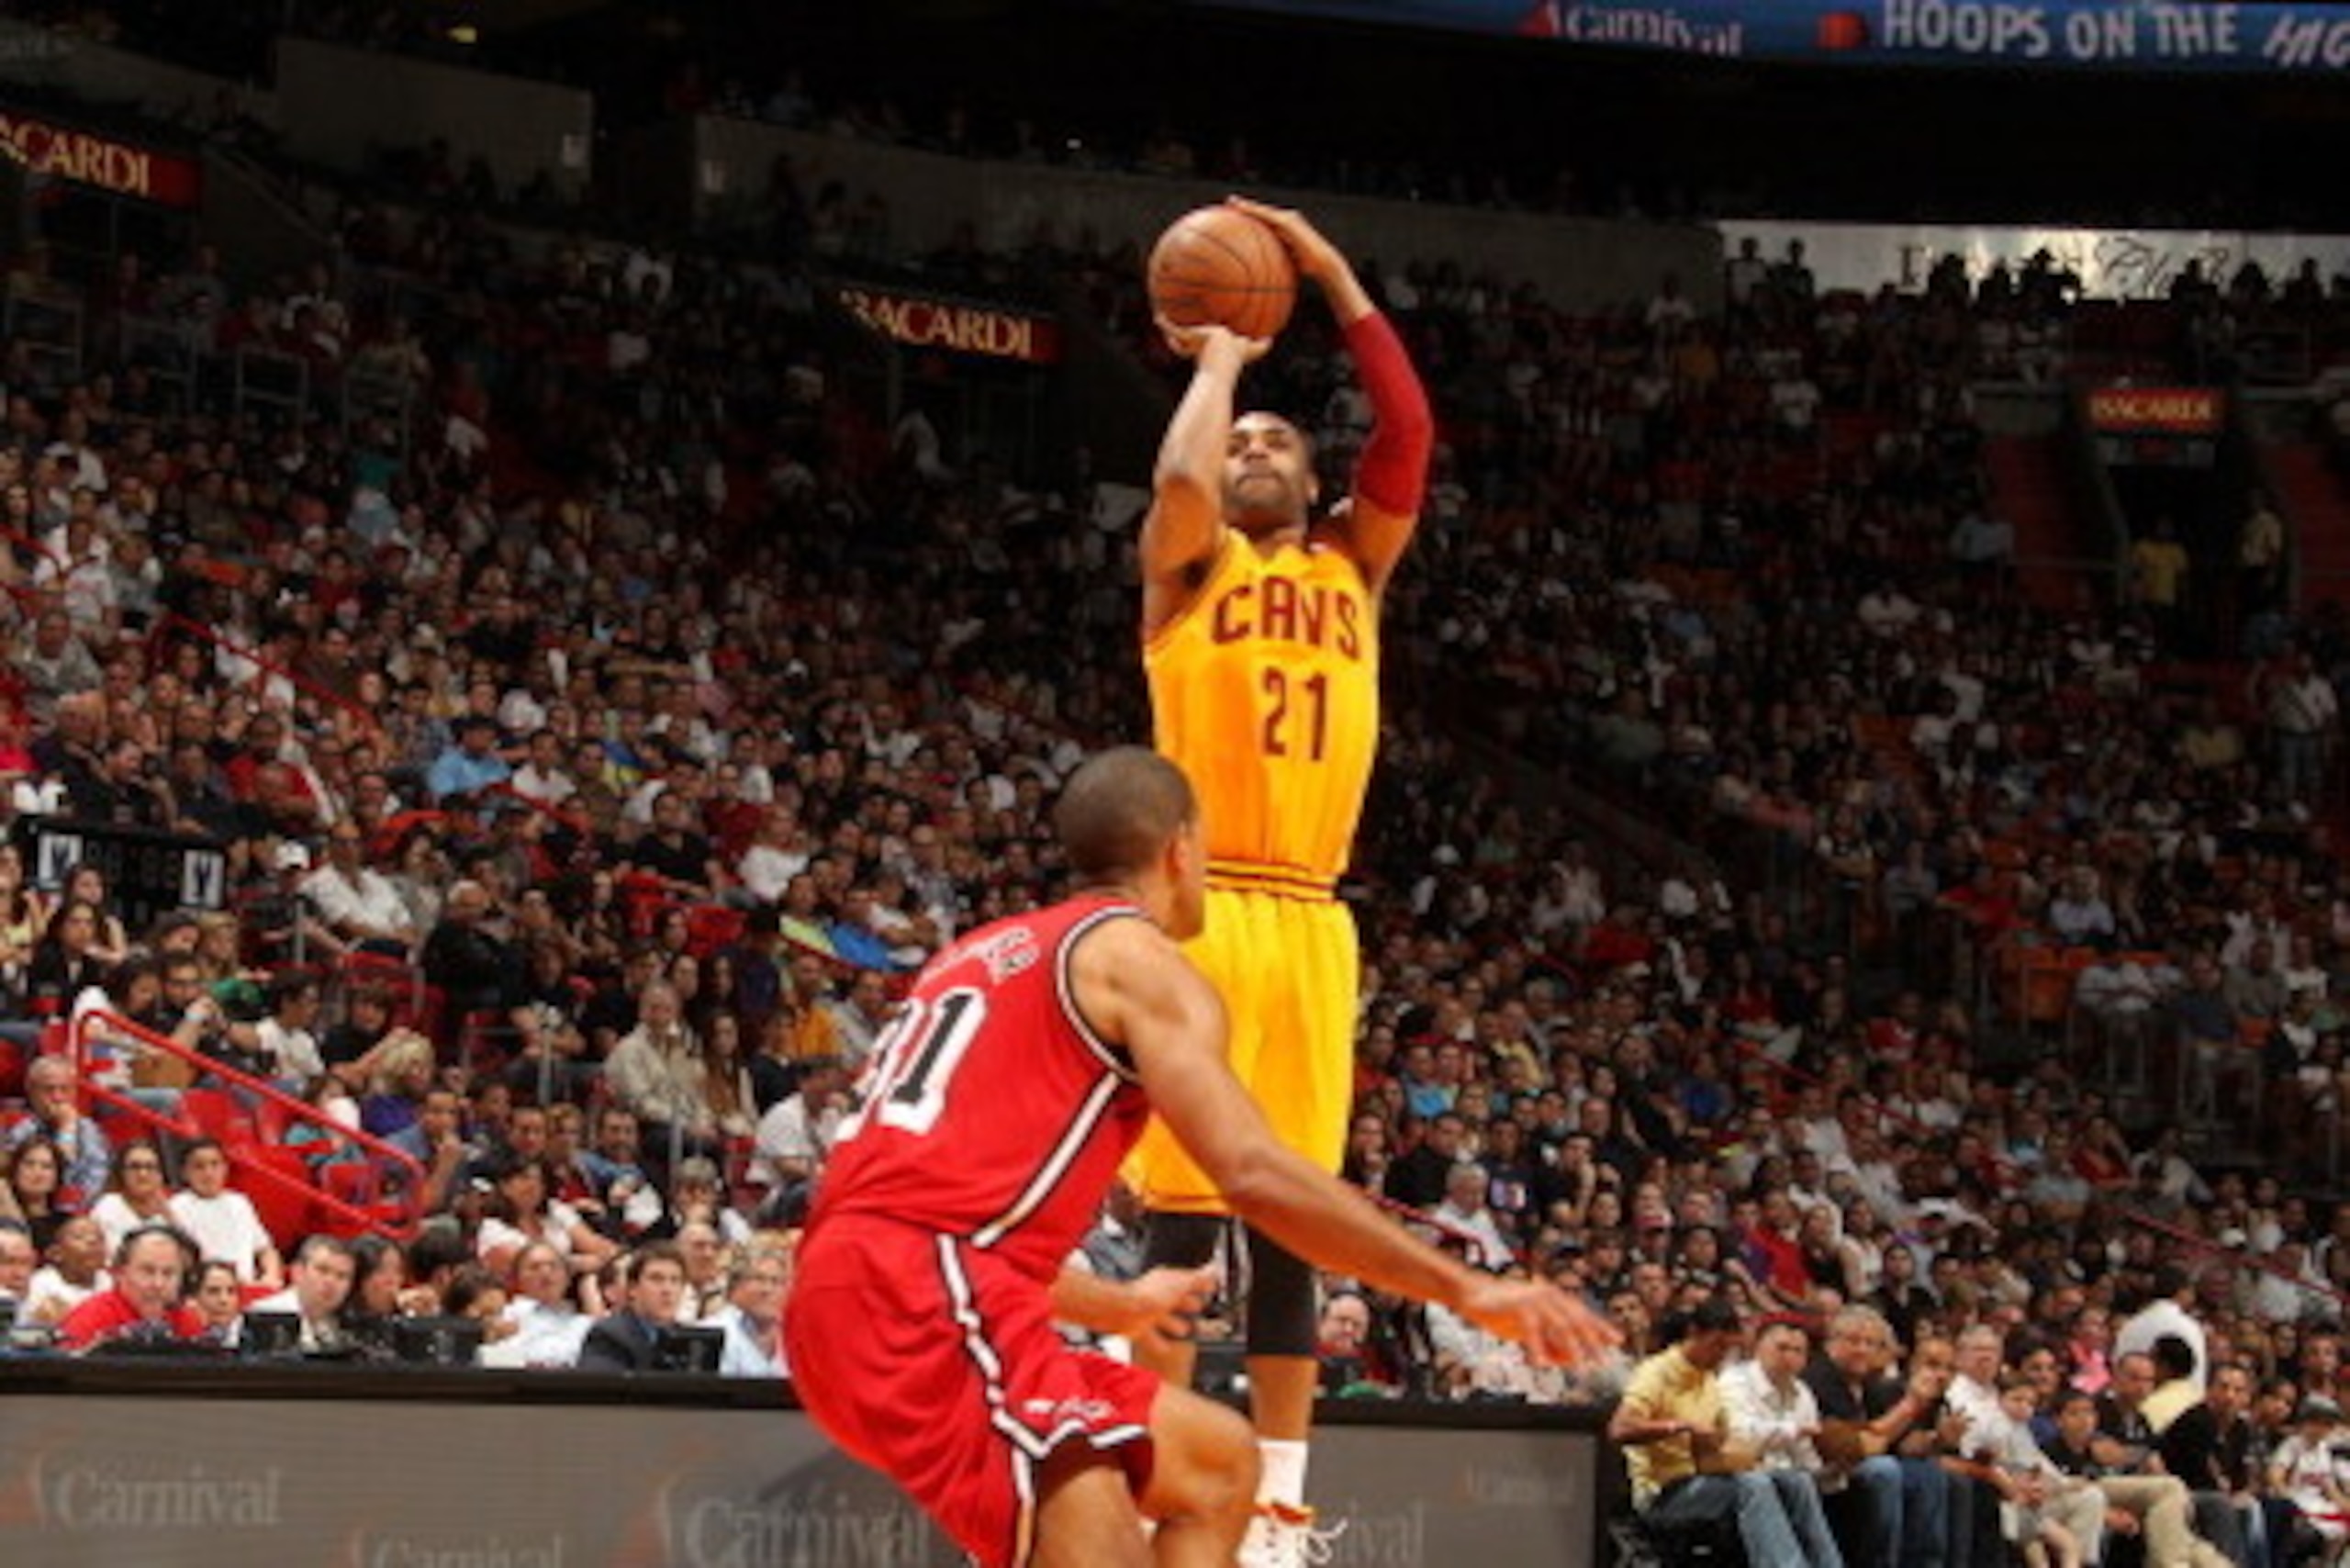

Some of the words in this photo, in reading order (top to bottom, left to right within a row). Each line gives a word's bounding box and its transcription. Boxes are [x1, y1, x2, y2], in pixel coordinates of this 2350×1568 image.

[1884, 0, 2049, 57] HOOPS
[2066, 12, 2135, 59] ON
[2150, 4, 2239, 56] THE
[1212, 575, 1361, 663] CAVS
[1263, 666, 1326, 761] 21
[55, 1465, 282, 1528] Carnival
